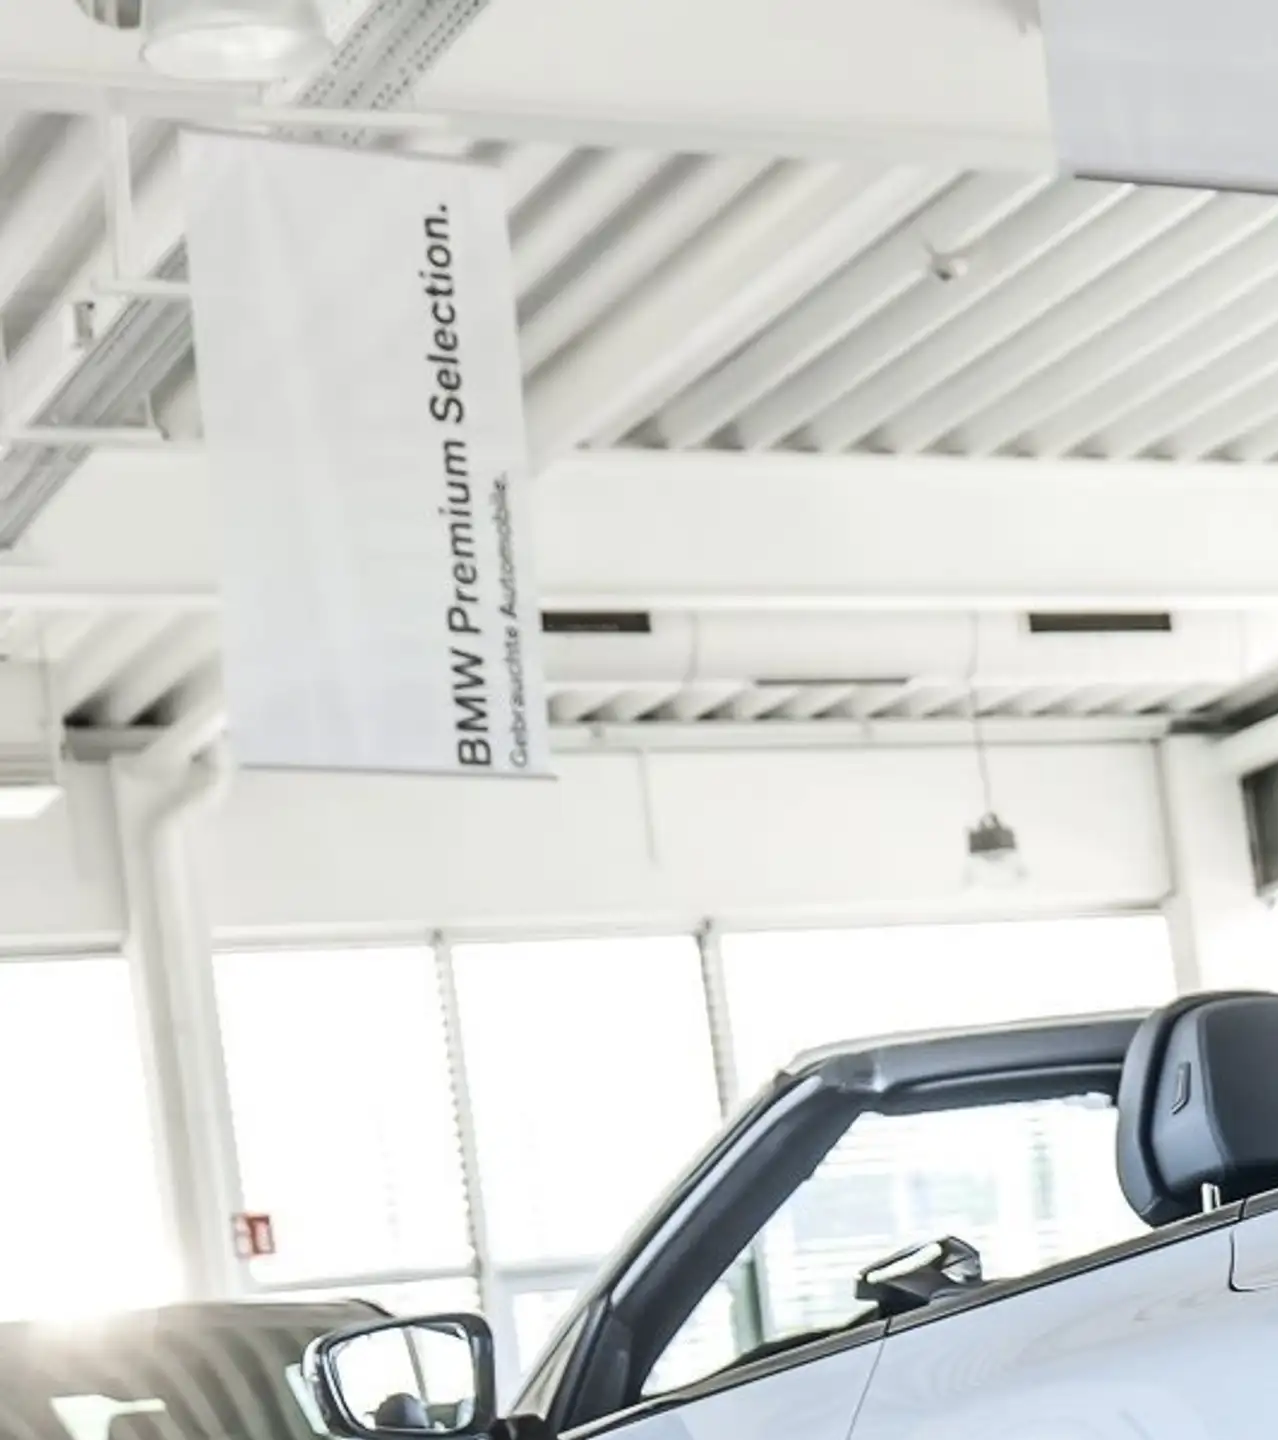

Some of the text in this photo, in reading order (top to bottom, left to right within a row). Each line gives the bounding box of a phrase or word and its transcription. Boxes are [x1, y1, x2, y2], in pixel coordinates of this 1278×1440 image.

[418, 203, 492, 767] BMW Premium Selection.
[503, 625, 529, 769] Gebrauchte
